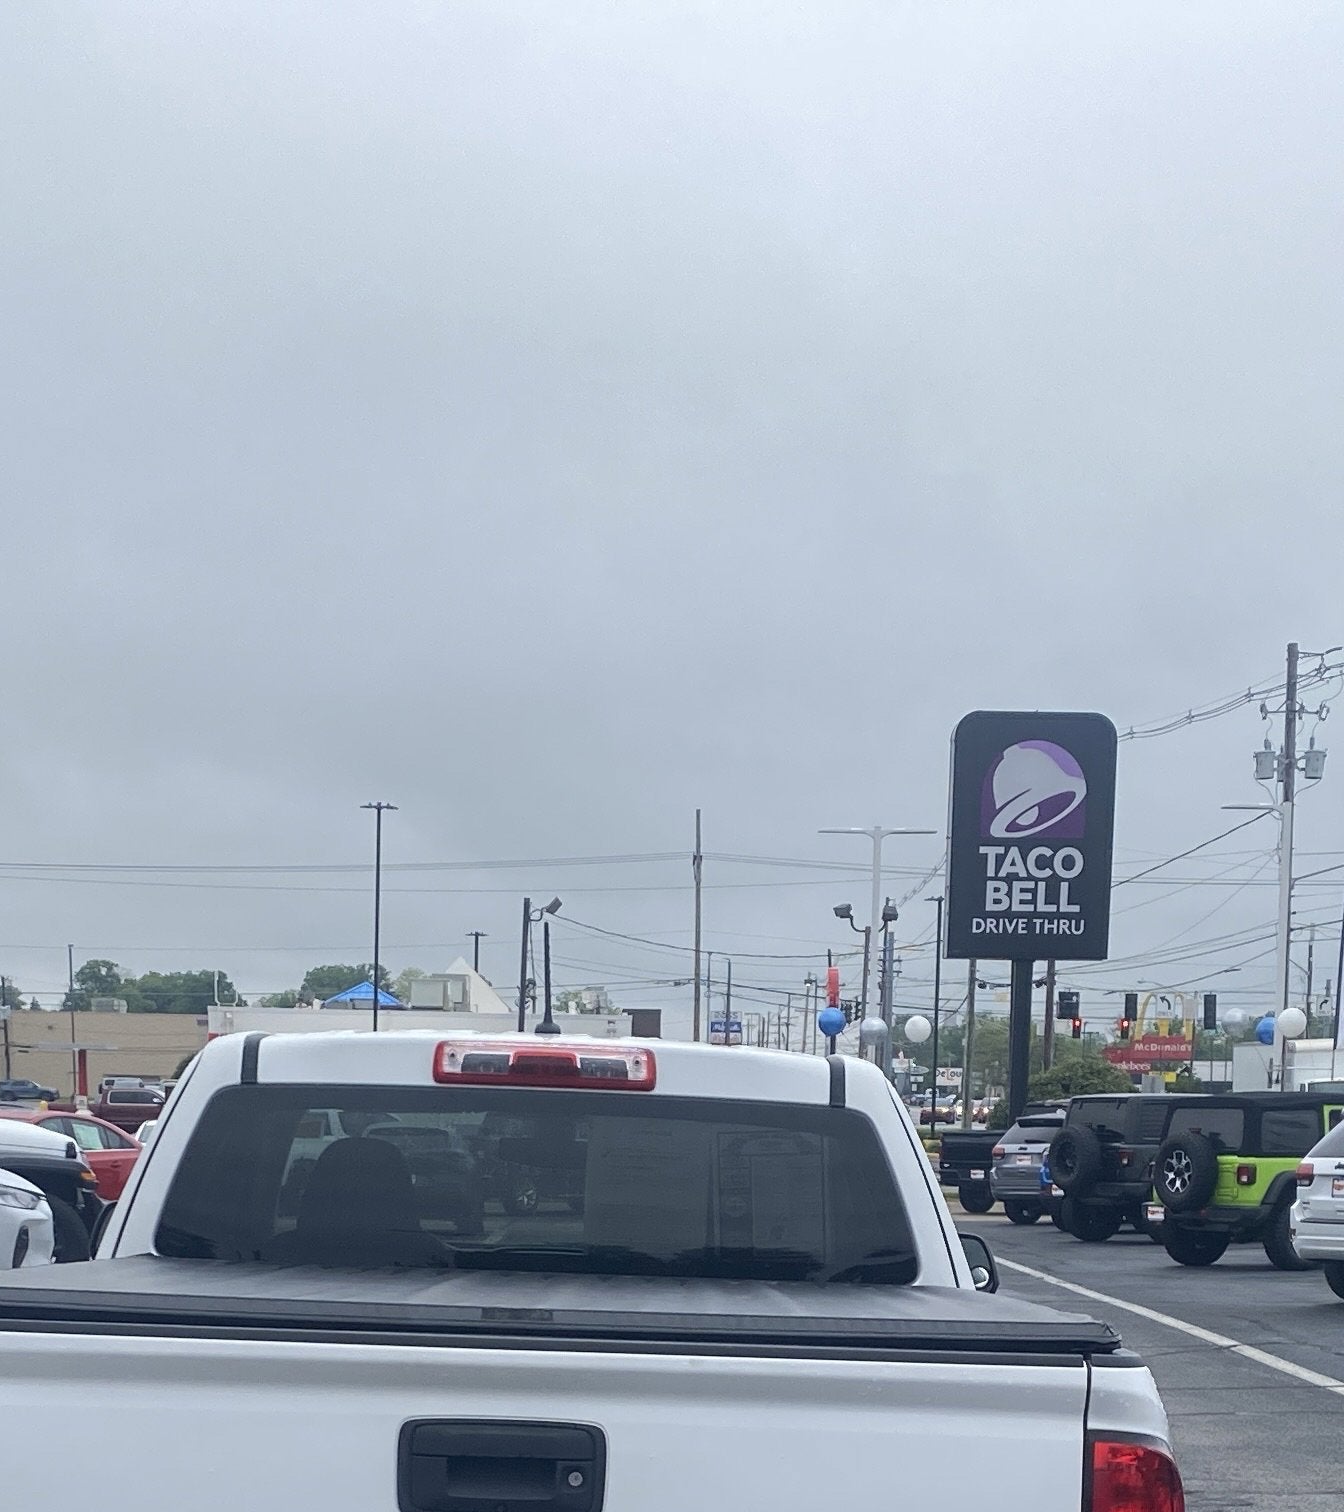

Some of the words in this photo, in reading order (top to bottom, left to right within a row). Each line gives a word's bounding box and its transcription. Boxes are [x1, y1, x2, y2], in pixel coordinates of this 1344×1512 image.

[979, 846, 1084, 879] TACO
[985, 880, 1081, 912] BELL
[971, 917, 1029, 934] DRIVE
[1033, 918, 1085, 935] THRU
